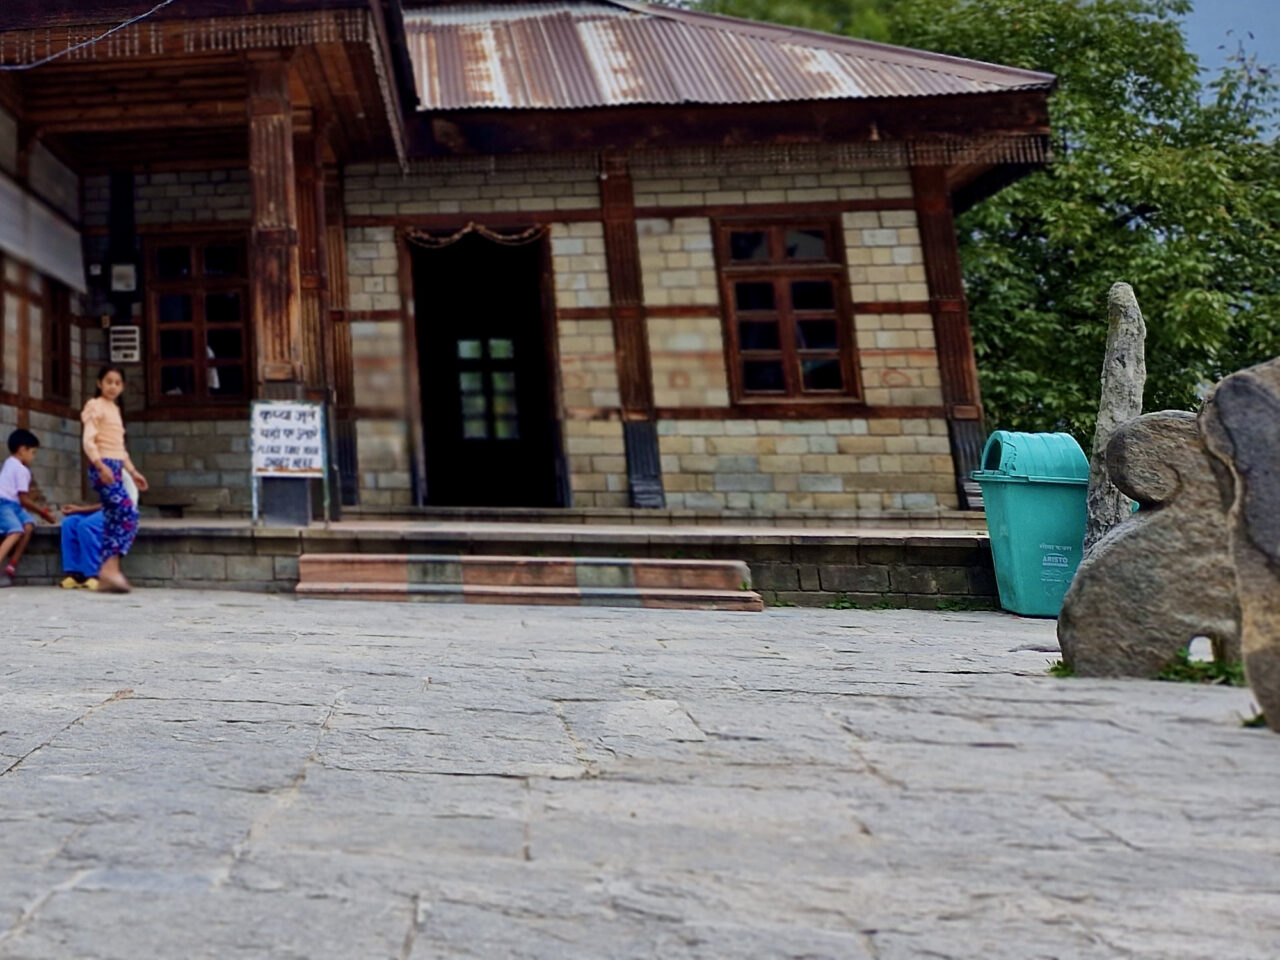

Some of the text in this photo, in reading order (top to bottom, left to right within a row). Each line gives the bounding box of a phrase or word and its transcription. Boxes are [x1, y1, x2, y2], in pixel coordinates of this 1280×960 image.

[257, 445, 282, 455] PLEASE
[263, 456, 313, 468] SHOES HERE
[1042, 555, 1069, 564] ARISTO
